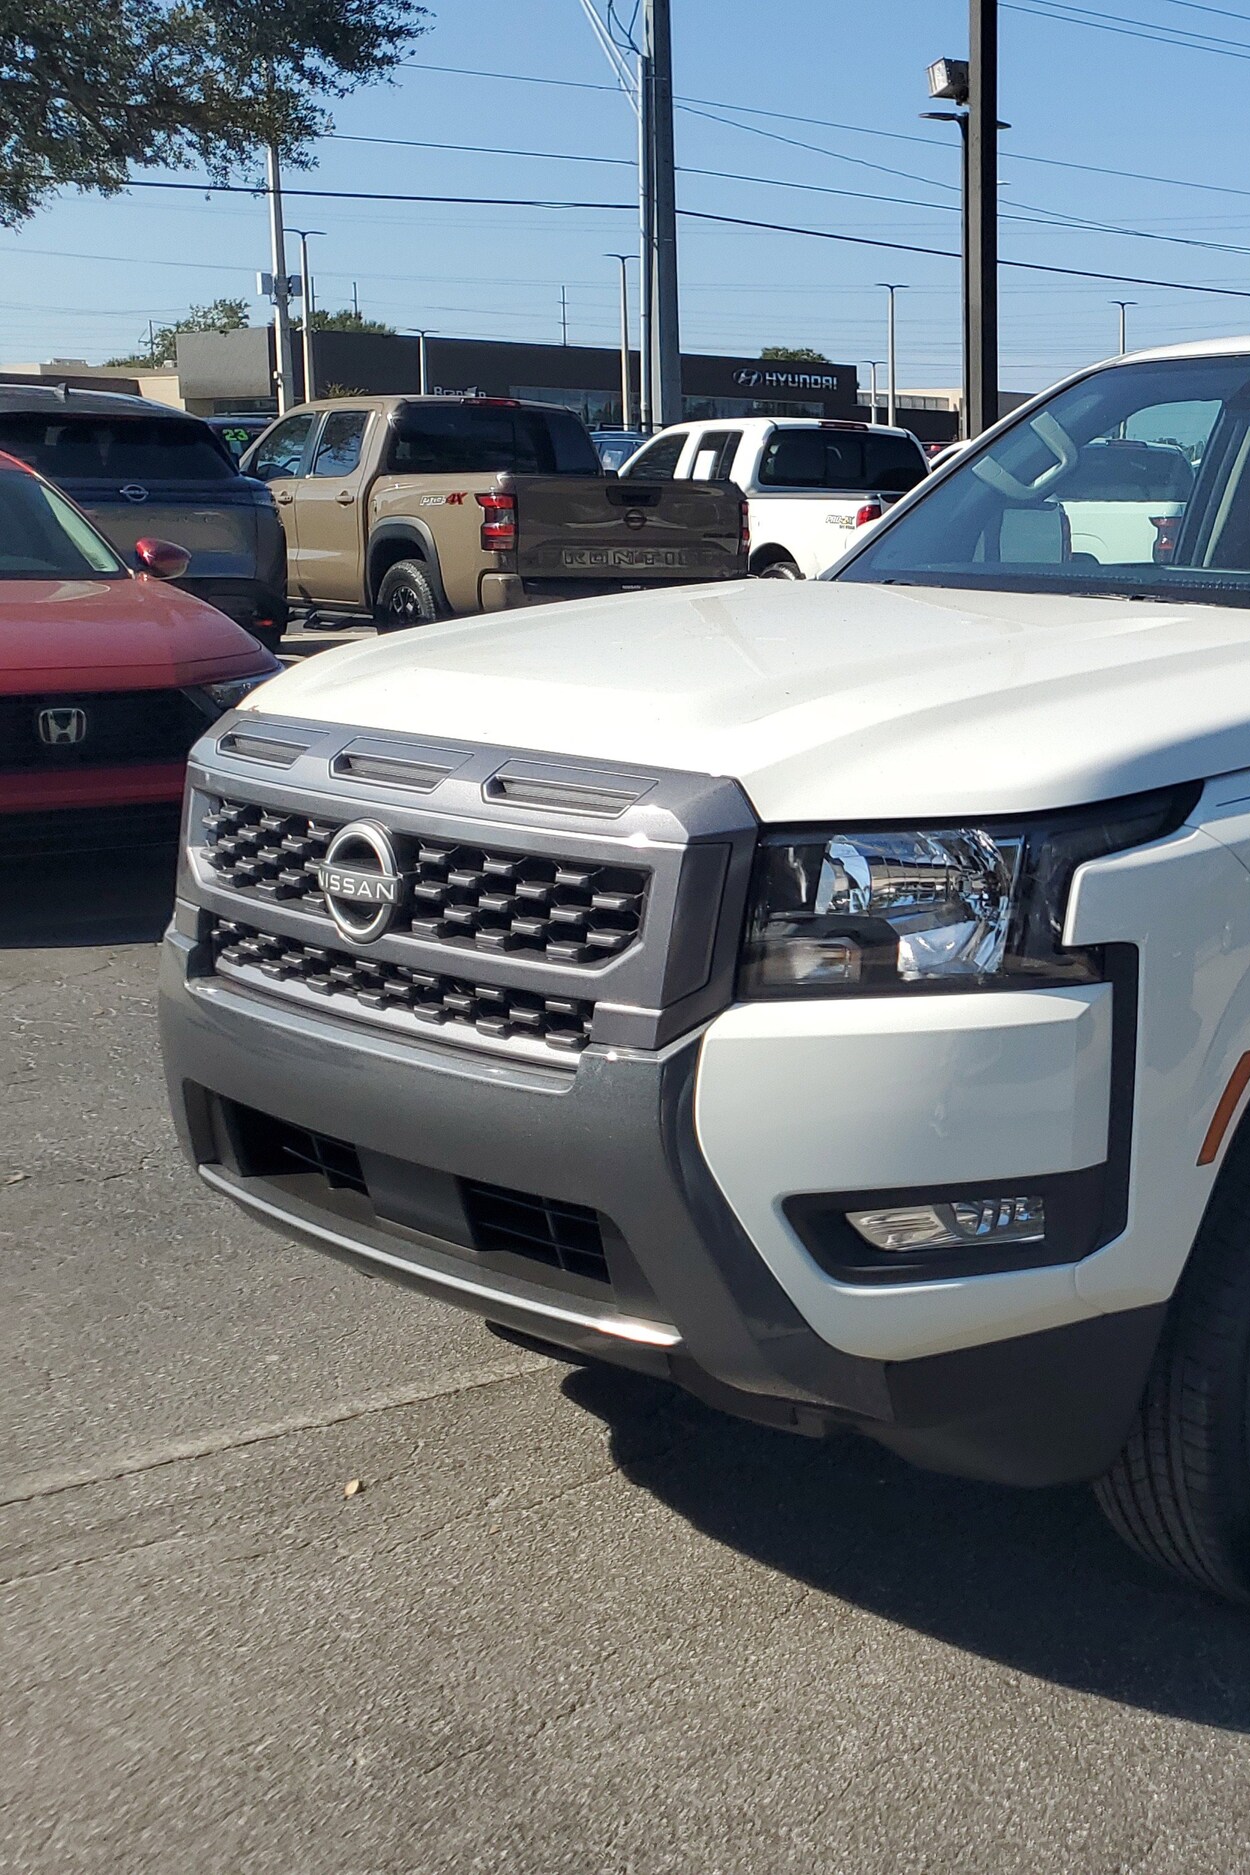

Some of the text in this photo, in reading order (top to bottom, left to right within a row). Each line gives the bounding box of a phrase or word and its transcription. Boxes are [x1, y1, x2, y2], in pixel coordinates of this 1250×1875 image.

[764, 372, 837, 390] HYUNDAI
[433, 386, 486, 397] Brann
[222, 429, 249, 441] 23
[318, 870, 394, 900] NISSAN
